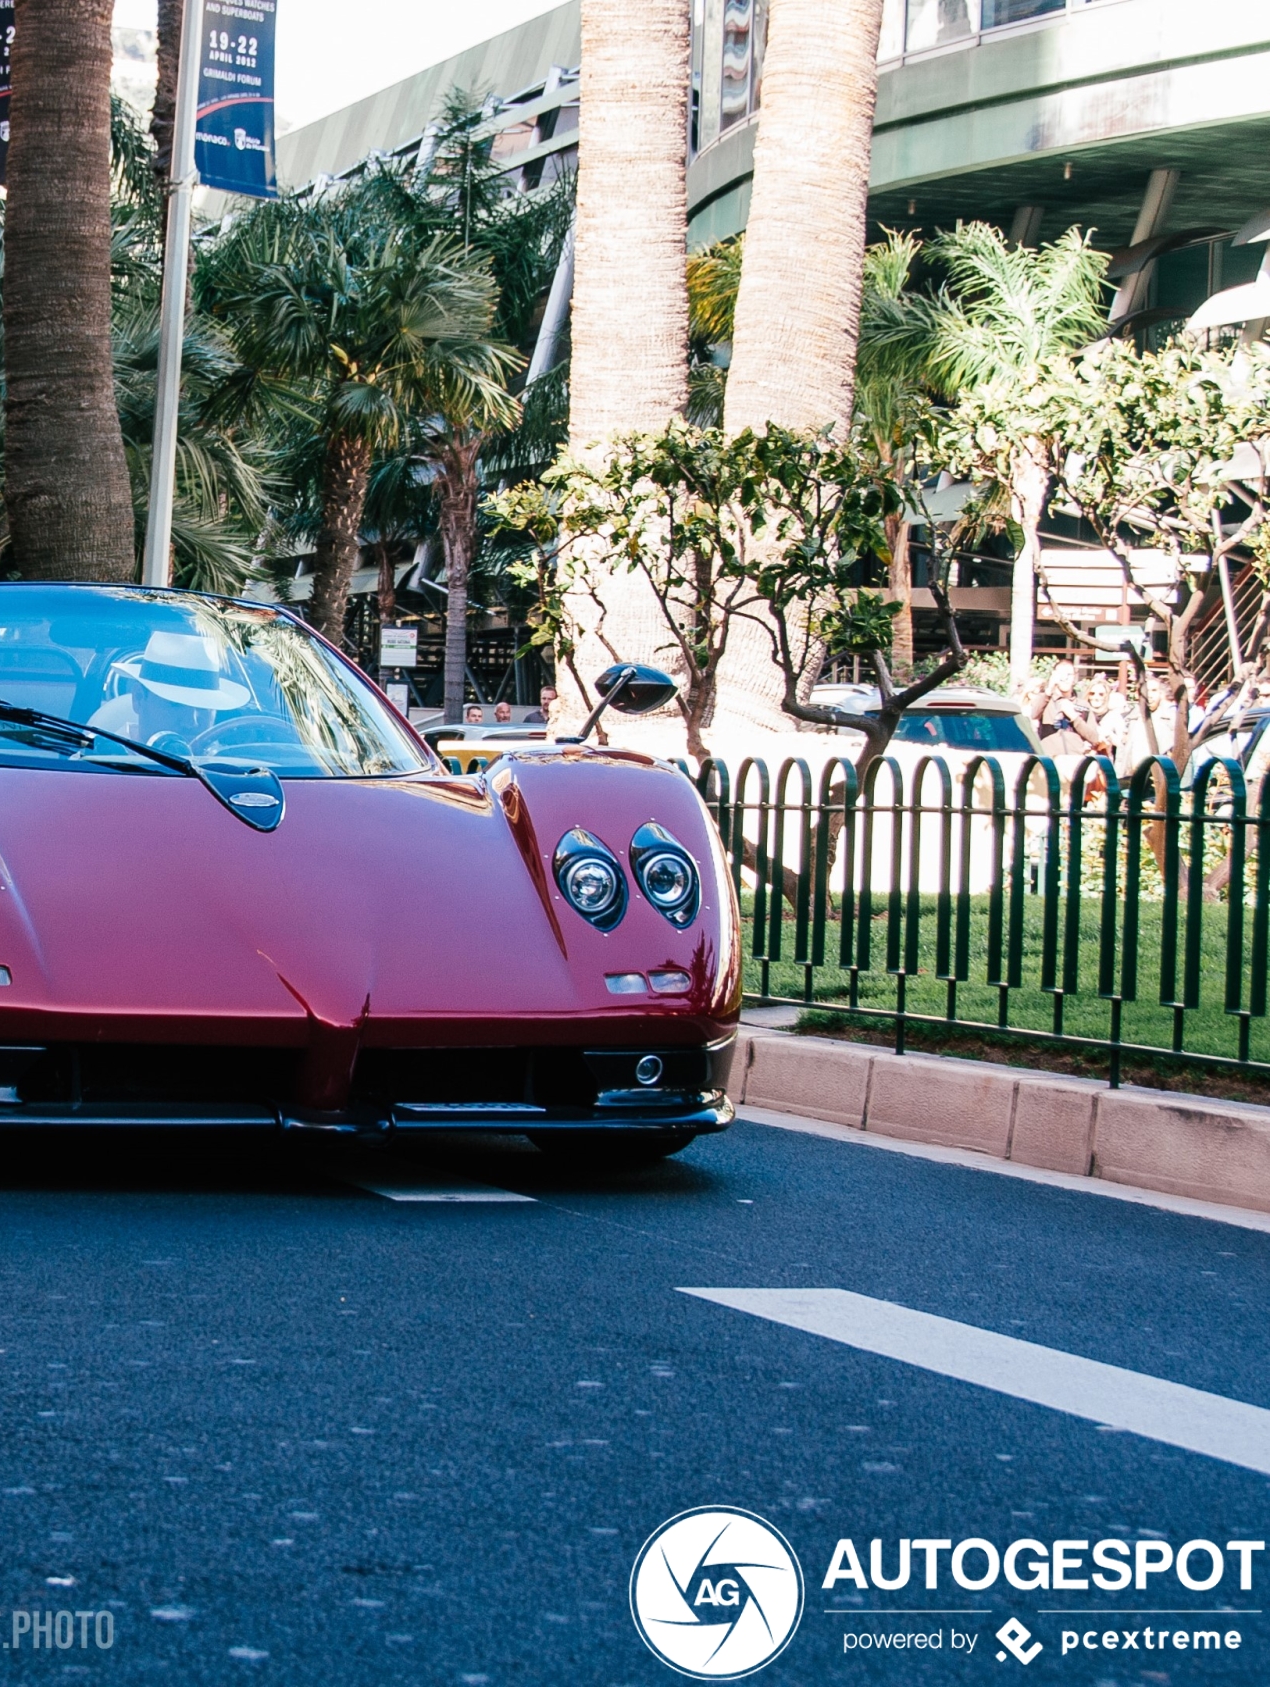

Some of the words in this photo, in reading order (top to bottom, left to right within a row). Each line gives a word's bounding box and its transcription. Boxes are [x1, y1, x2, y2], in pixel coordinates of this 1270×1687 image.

[205, 2, 221, 13] AND
[221, 5, 265, 22] SUPERBOATS
[209, 50, 233, 64] APRIL
[235, 54, 257, 68] 2012
[203, 67, 237, 83] GRIMALDI
[237, 73, 262, 86] FORUM
